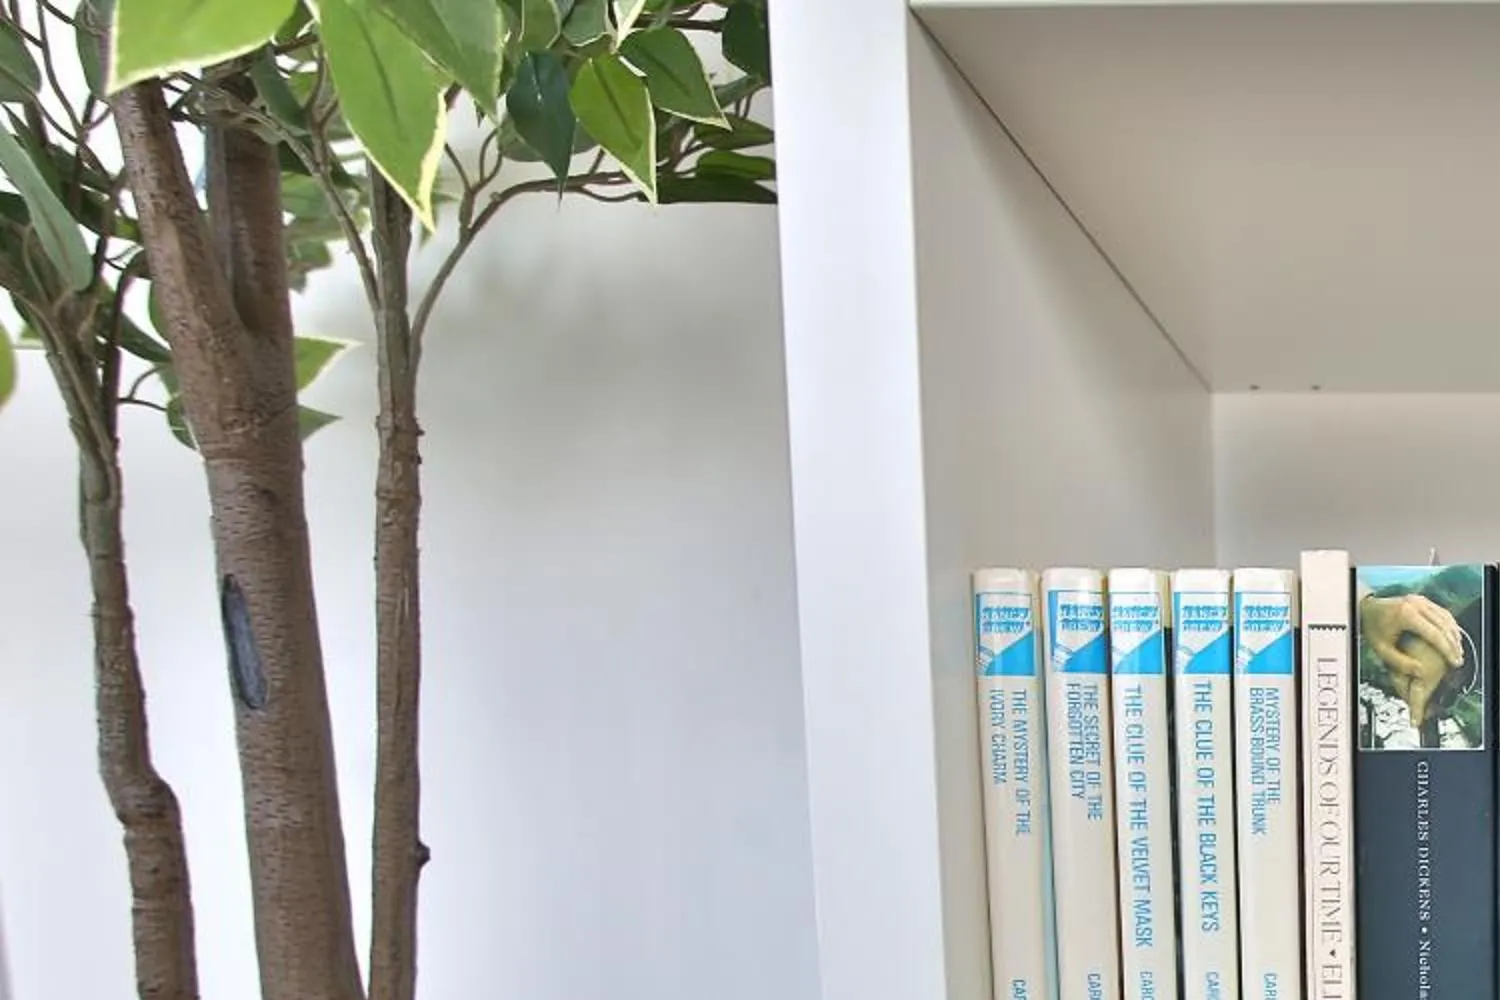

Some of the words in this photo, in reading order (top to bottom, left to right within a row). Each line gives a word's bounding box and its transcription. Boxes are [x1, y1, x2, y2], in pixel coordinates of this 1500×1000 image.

[990, 689, 1006, 728] IVORY
[1012, 690, 1027, 713] THE
[1084, 683, 1099, 709] THE
[1124, 685, 1142, 717] THE
[1194, 682, 1212, 712] THE
[1067, 683, 1084, 765] FORGOTTEN
[1265, 688, 1280, 752] MYSTERY
[1317, 657, 1339, 775] LEGENDS
[992, 734, 1008, 784] CHARM
[1014, 719, 1030, 783] MYSTERY
[1085, 715, 1101, 765] SECRET
[1125, 724, 1143, 764] CLUE
[1195, 720, 1214, 760] CLUE
[1070, 770, 1085, 799] CITY
[1087, 772, 1101, 790] OF
[1127, 771, 1145, 792] OF
[1197, 767, 1214, 788] OF
[1266, 757, 1280, 776] OF
[1016, 788, 1031, 806] OF
[1088, 796, 1102, 820] THE
[1198, 795, 1216, 825] THE
[1266, 780, 1280, 805] THE
[1319, 781, 1340, 817] OF
[1417, 761, 1429, 841] CHARLES
[1016, 811, 1032, 835] THE
[1130, 799, 1147, 830] THE
[1252, 791, 1266, 835] TRUNK
[1131, 837, 1150, 892] VELVET
[1199, 833, 1217, 884] BLACK
[1319, 821, 1341, 875] OUR
[1418, 847, 1430, 921] DICKENS
[1134, 899, 1153, 948] MASK
[1201, 891, 1219, 933] KEYS
[1321, 880, 1343, 942] TIME
